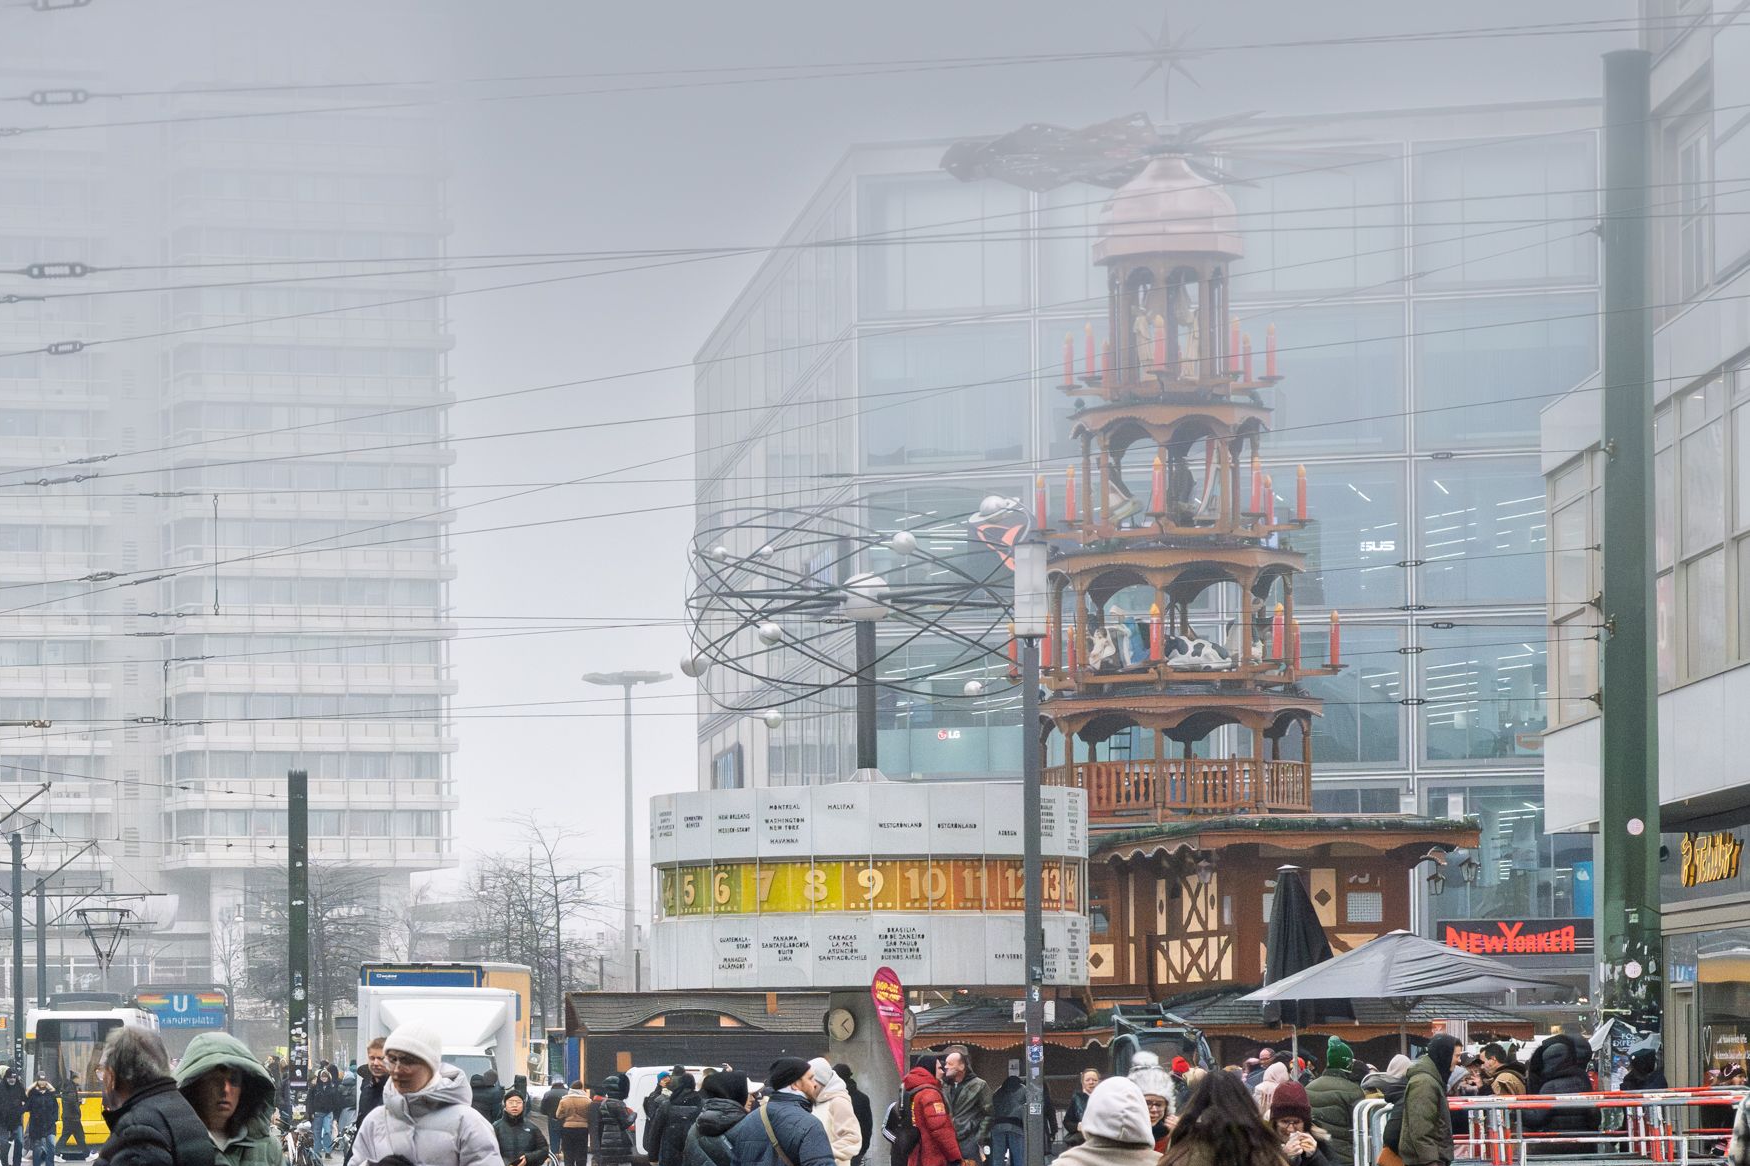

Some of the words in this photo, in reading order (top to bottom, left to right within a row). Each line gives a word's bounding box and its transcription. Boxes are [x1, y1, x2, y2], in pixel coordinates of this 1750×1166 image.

[684, 874, 695, 905] 5
[714, 871, 731, 905] 6
[752, 870, 777, 902] 7
[803, 869, 828, 902] 8
[857, 868, 884, 900] 9
[904, 868, 947, 900] 10
[1041, 868, 1061, 900] 13
[173, 995, 188, 1012] U
